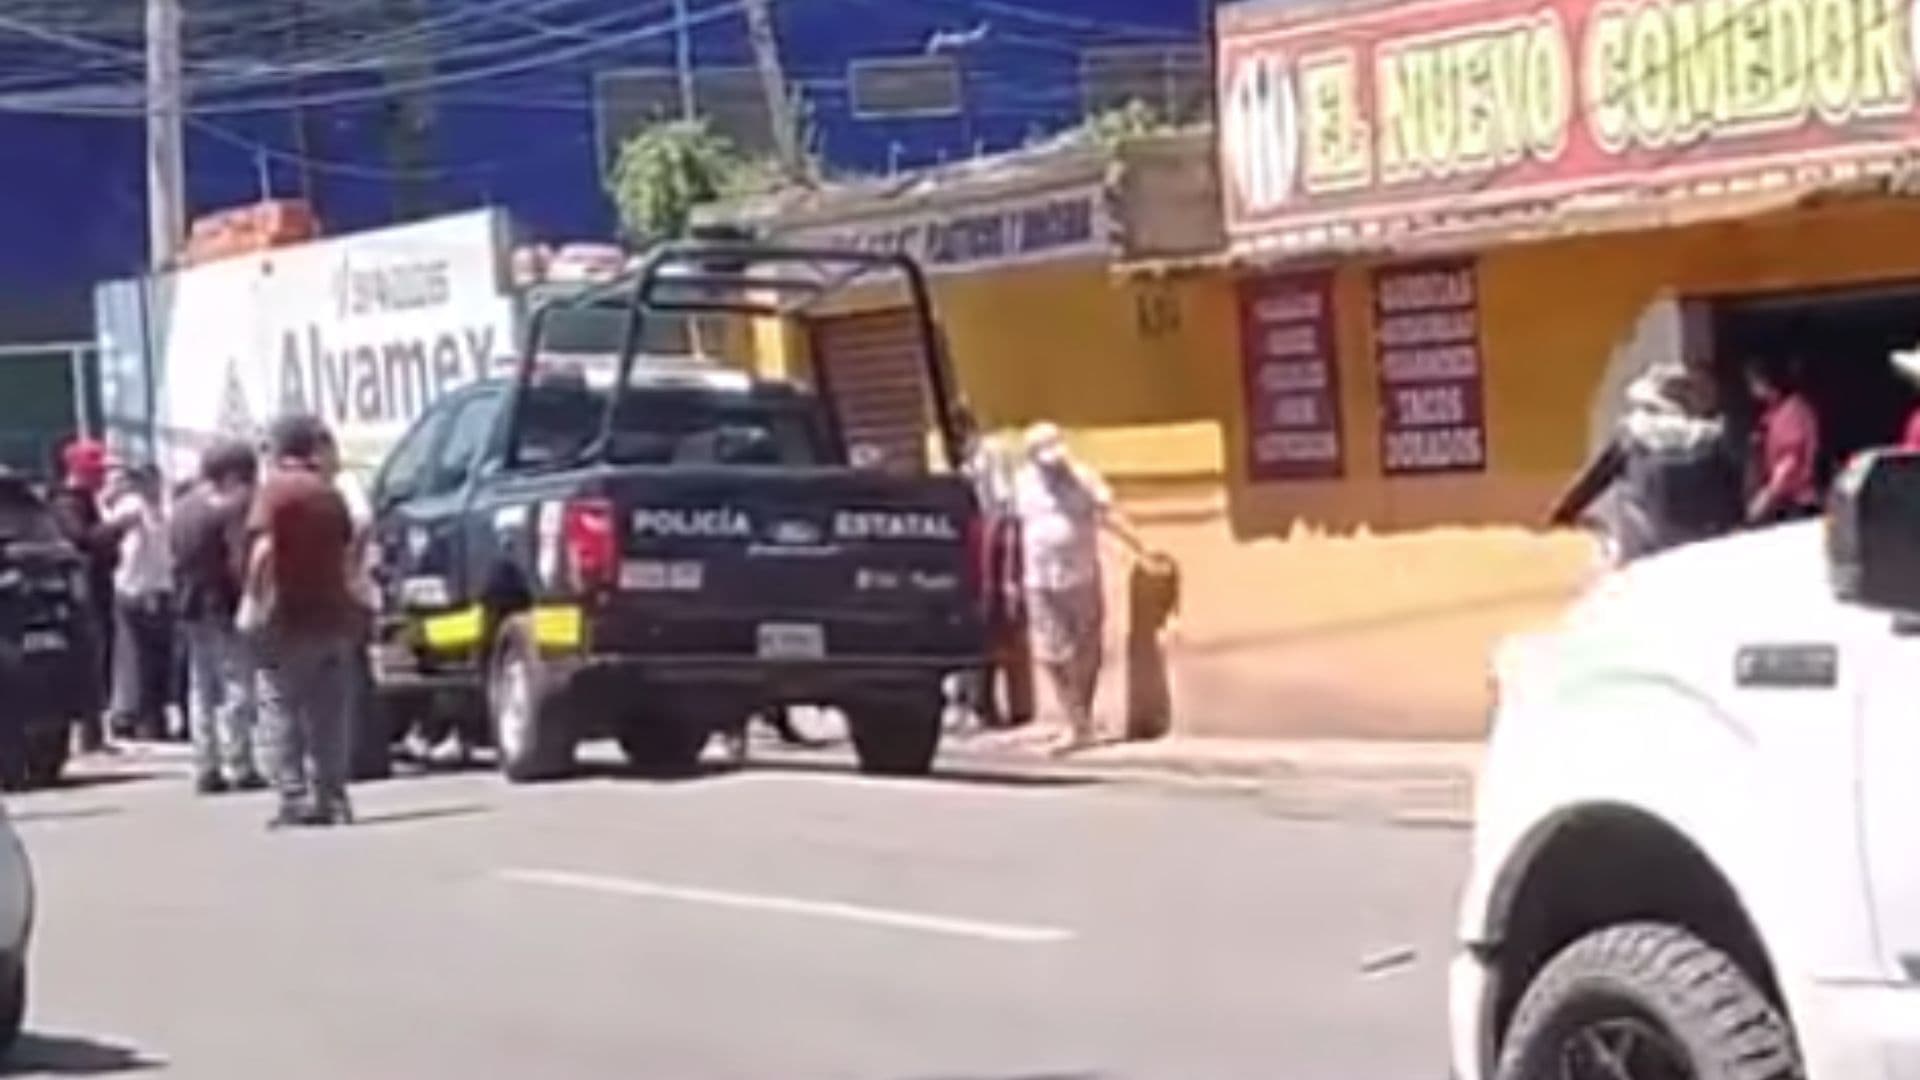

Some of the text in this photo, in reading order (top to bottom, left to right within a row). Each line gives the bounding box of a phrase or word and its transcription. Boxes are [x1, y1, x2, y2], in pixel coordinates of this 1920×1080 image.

[1304, 0, 1909, 190] EL NUEVO COMEDOR
[279, 321, 494, 421] Alvamex
[1396, 387, 1463, 425] TACOS
[1385, 428, 1482, 468] DORADOS
[632, 506, 751, 538] POLICÍA
[833, 512, 958, 540] ESTATAL
